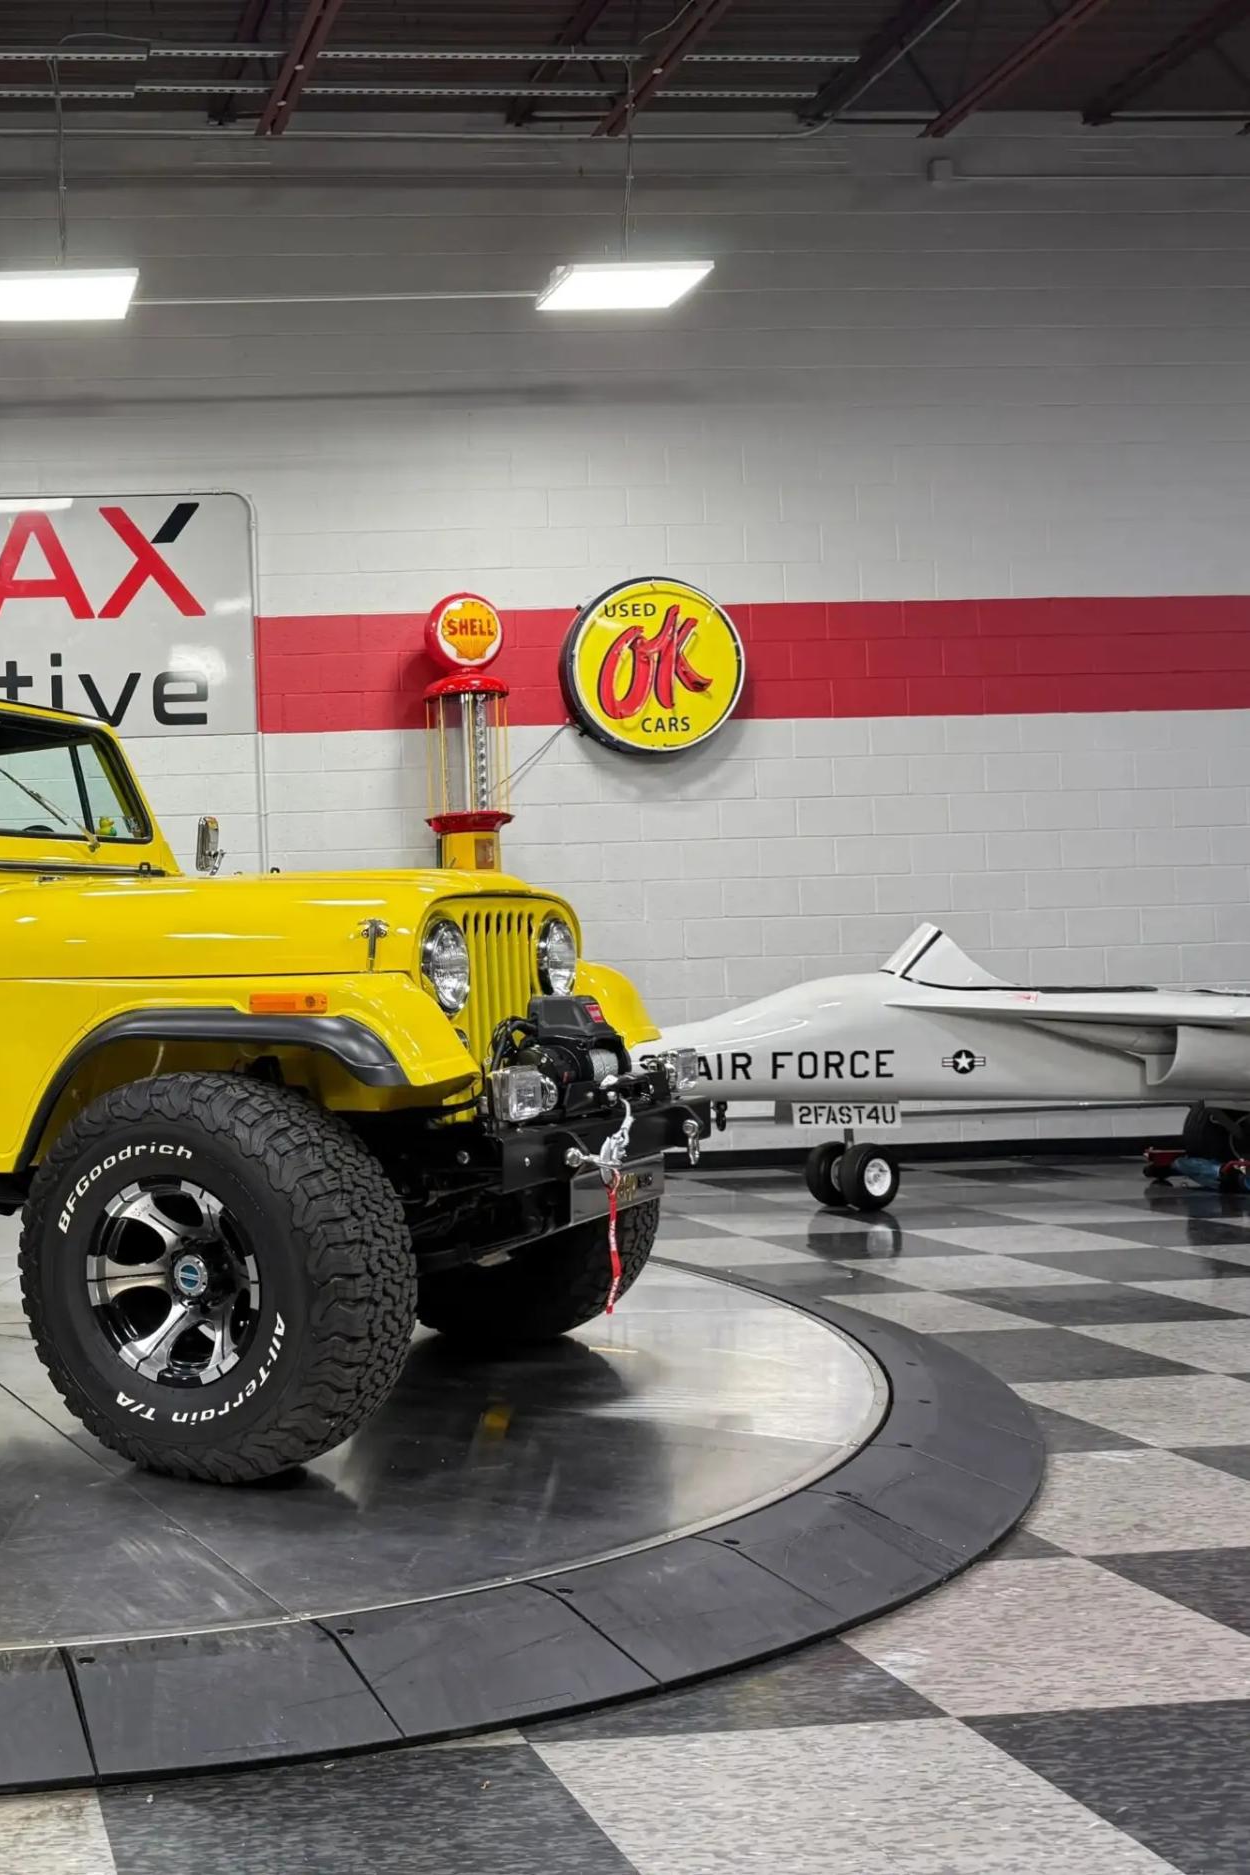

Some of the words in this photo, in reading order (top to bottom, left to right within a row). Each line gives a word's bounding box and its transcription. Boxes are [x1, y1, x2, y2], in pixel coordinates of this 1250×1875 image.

[604, 603, 656, 618] USED
[446, 618, 495, 637] SHELL
[598, 604, 713, 719] OK
[641, 716, 691, 733] CARS
[771, 1049, 895, 1080] FORCE
[798, 1105, 896, 1125] 2FAST4U
[57, 1141, 193, 1234] BFGoodrich
[171, 1311, 286, 1426] All-Terrain
[115, 1390, 156, 1422] T/A
